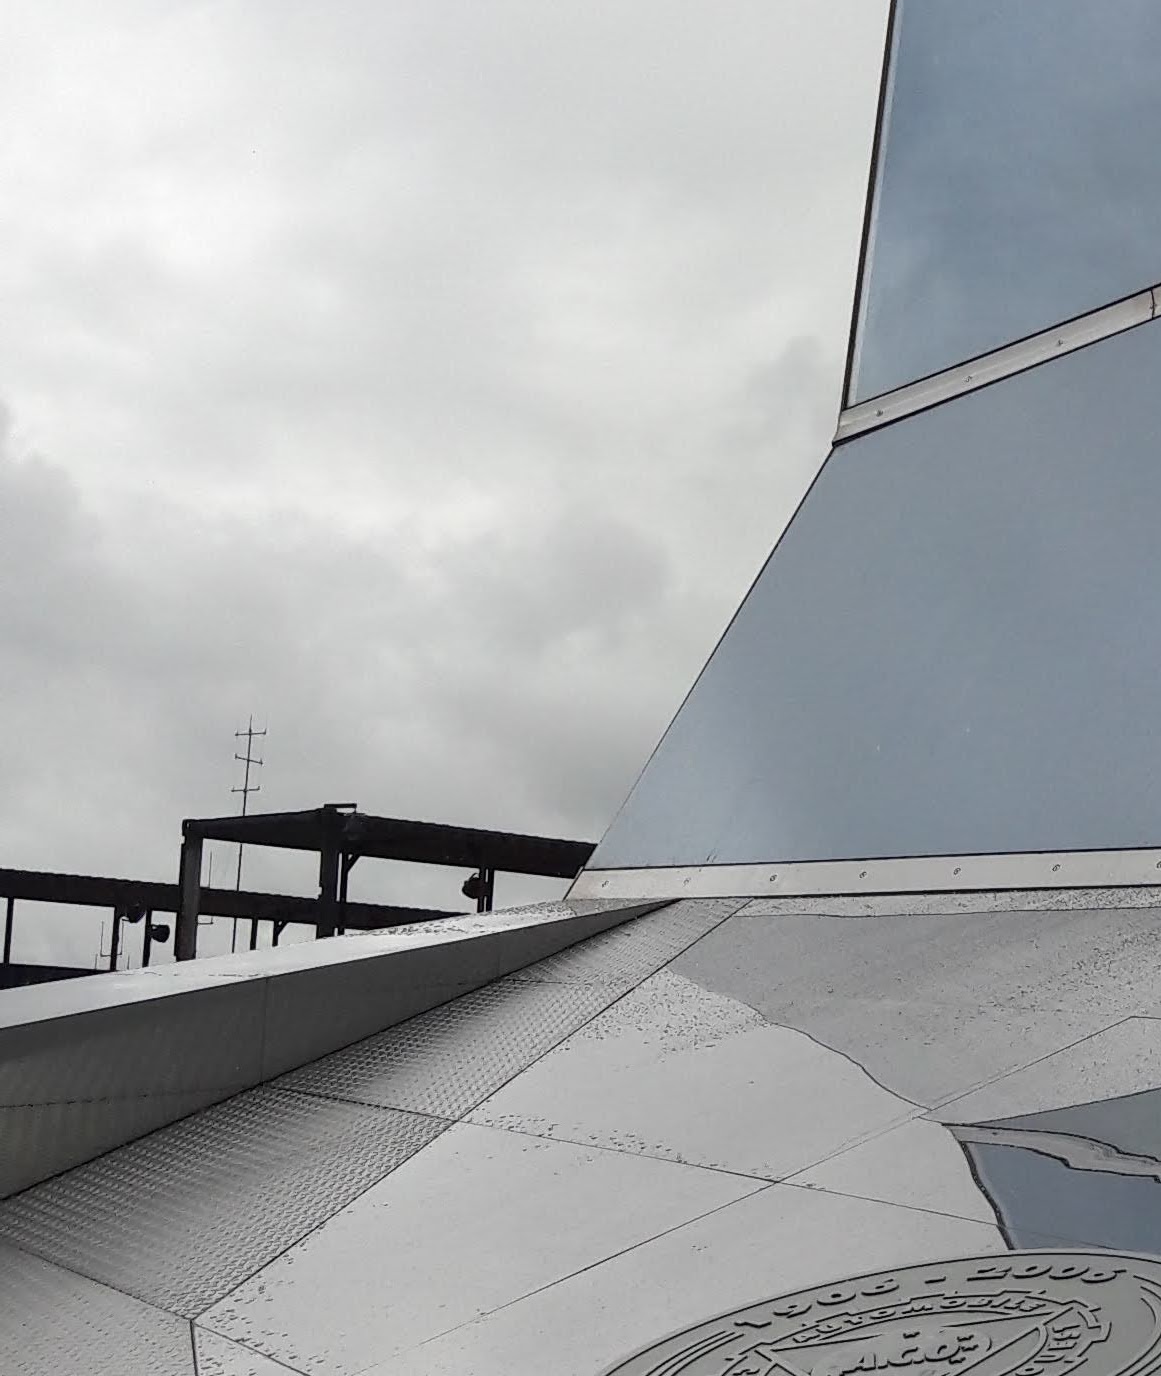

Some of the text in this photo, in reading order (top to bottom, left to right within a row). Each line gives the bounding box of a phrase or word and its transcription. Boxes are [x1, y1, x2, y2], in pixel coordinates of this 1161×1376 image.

[733, 1276, 900, 1328] 1906
[966, 1263, 1128, 1284] 2006
[793, 1297, 1047, 1343] AUTOMOBILE
